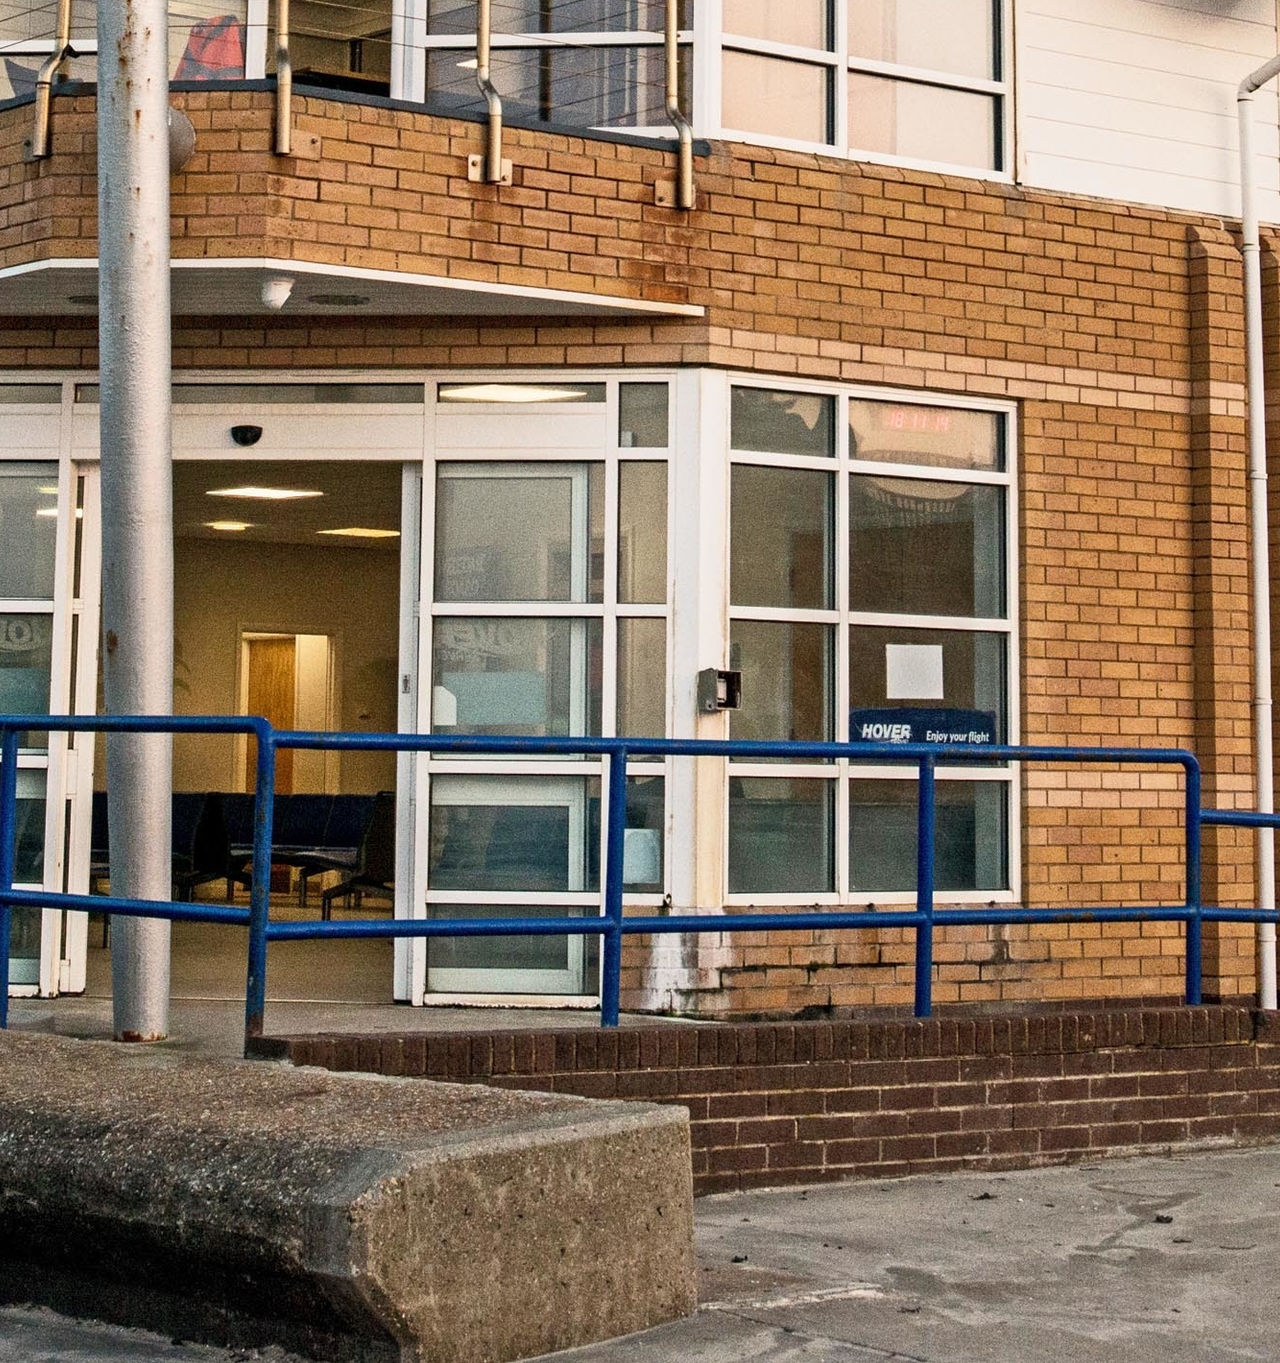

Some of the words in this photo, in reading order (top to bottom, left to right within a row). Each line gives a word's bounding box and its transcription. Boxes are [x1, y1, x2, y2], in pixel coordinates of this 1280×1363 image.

[862, 723, 911, 739] HOVER
[926, 730, 948, 743] Enjoy
[949, 732, 967, 743] your
[968, 731, 990, 744] flight
